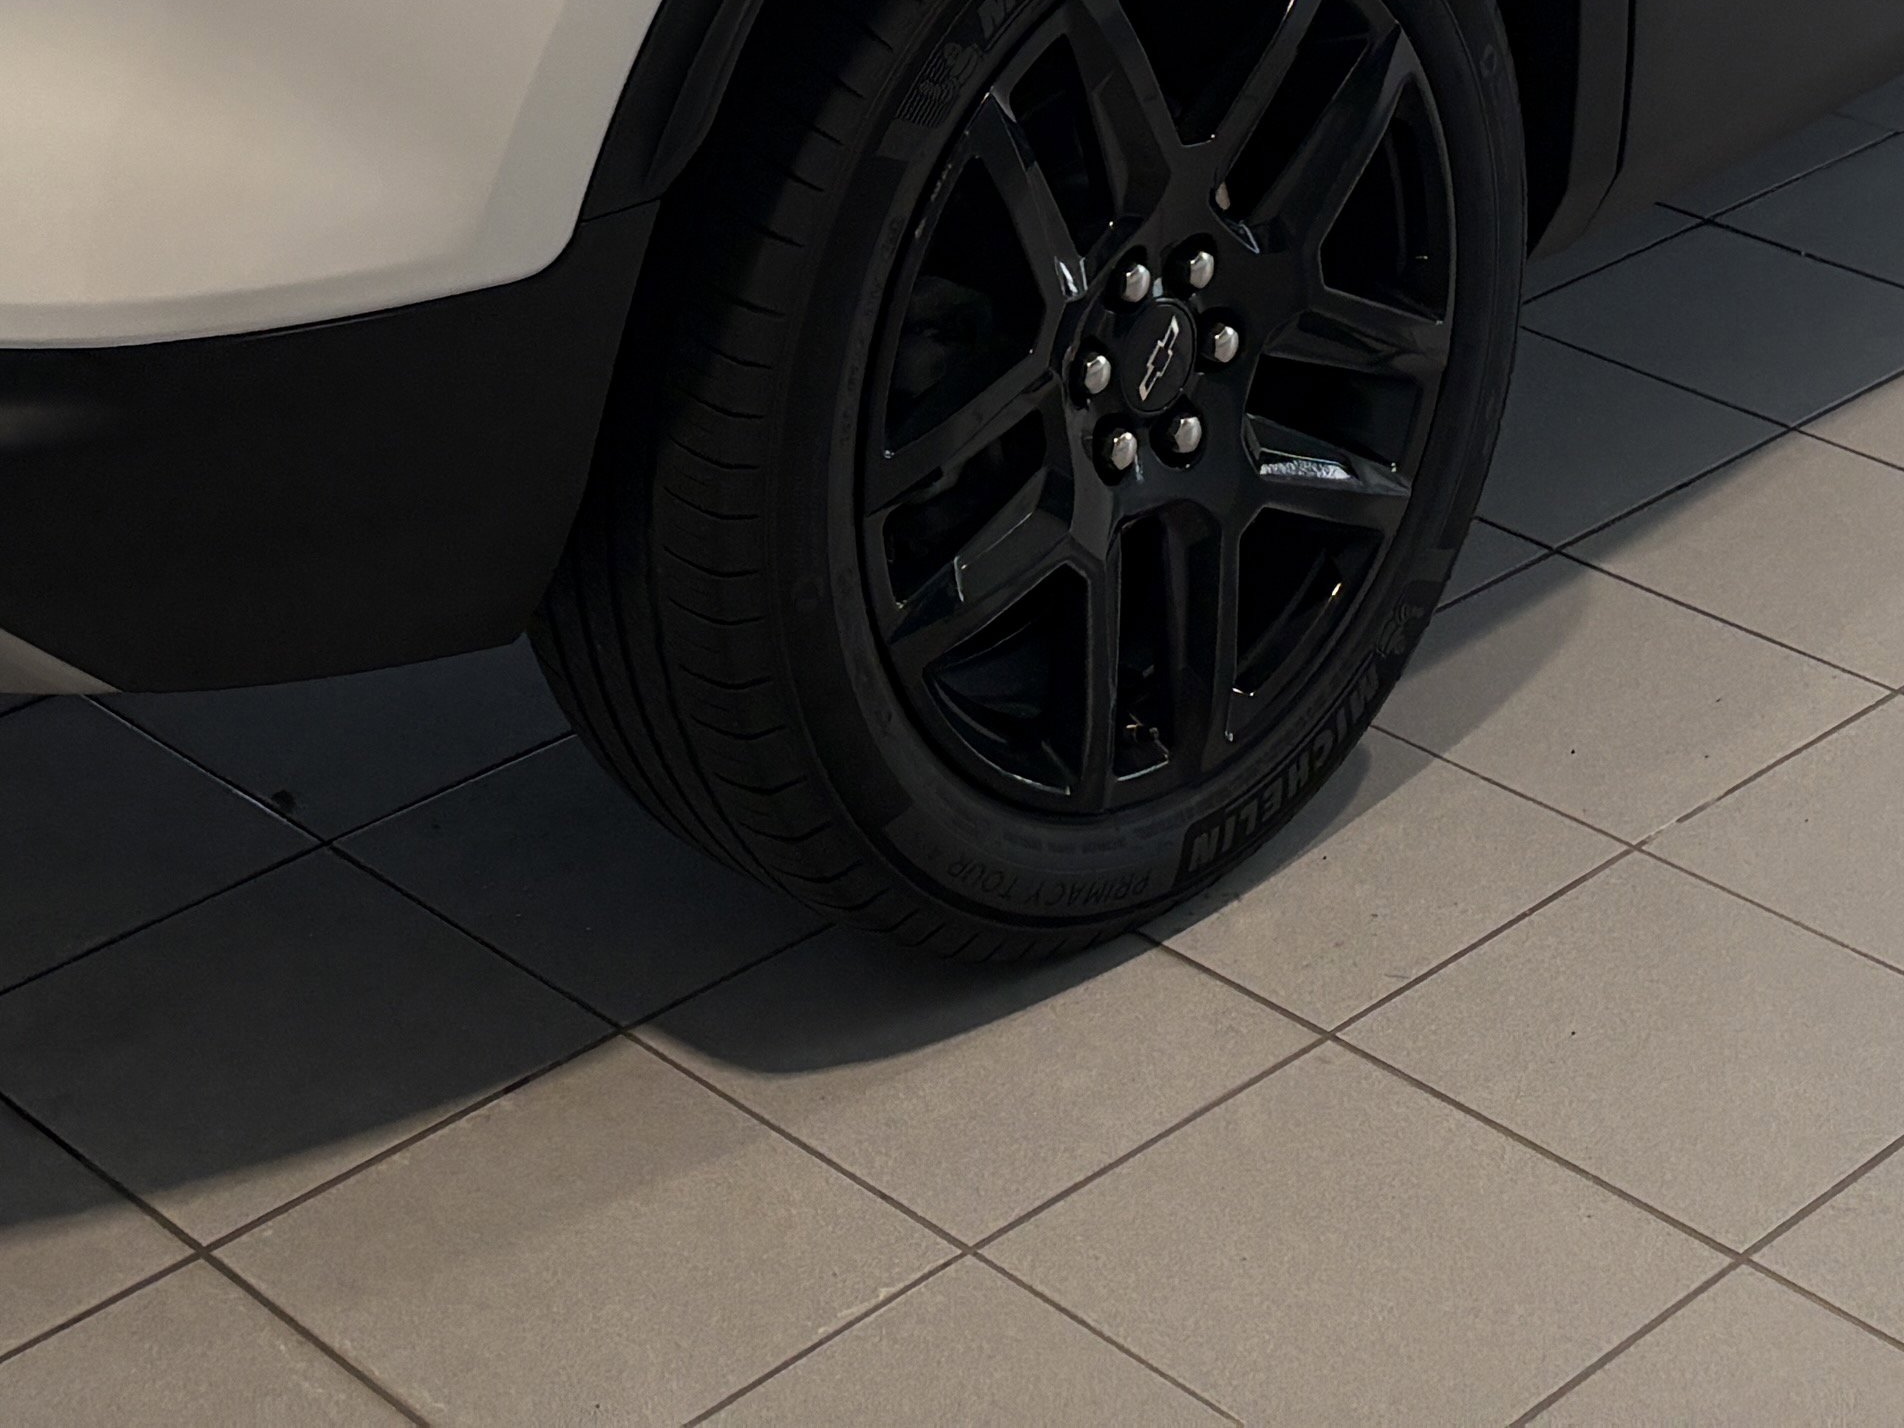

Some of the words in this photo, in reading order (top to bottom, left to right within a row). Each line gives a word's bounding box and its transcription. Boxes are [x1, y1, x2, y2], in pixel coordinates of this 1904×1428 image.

[1193, 664, 1379, 869] MICHELIN
[946, 853, 1018, 901] TOUR
[1024, 867, 1152, 908] PRIMACY
